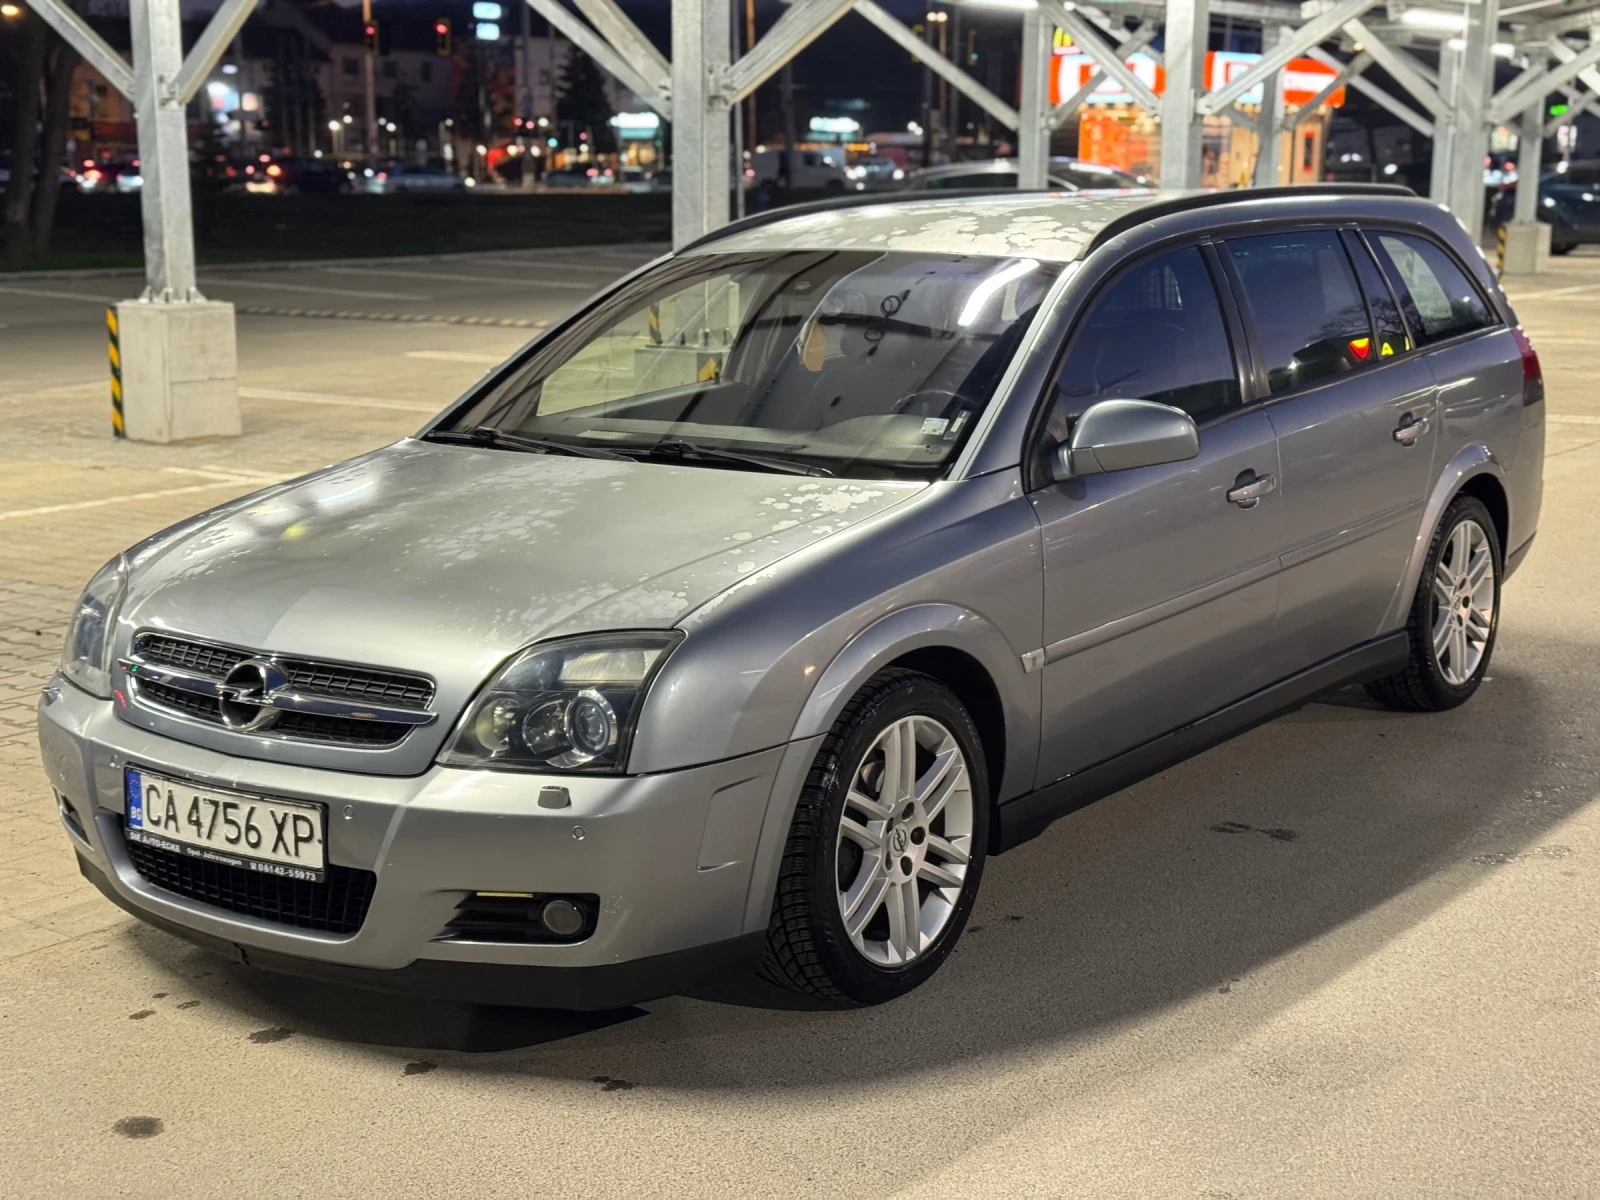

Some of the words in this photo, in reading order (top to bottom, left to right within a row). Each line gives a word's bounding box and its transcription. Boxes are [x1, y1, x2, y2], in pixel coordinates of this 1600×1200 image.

[130, 806, 142, 820] BG
[146, 784, 180, 833] CA
[187, 795, 262, 848] 4756
[269, 810, 315, 857] XP
